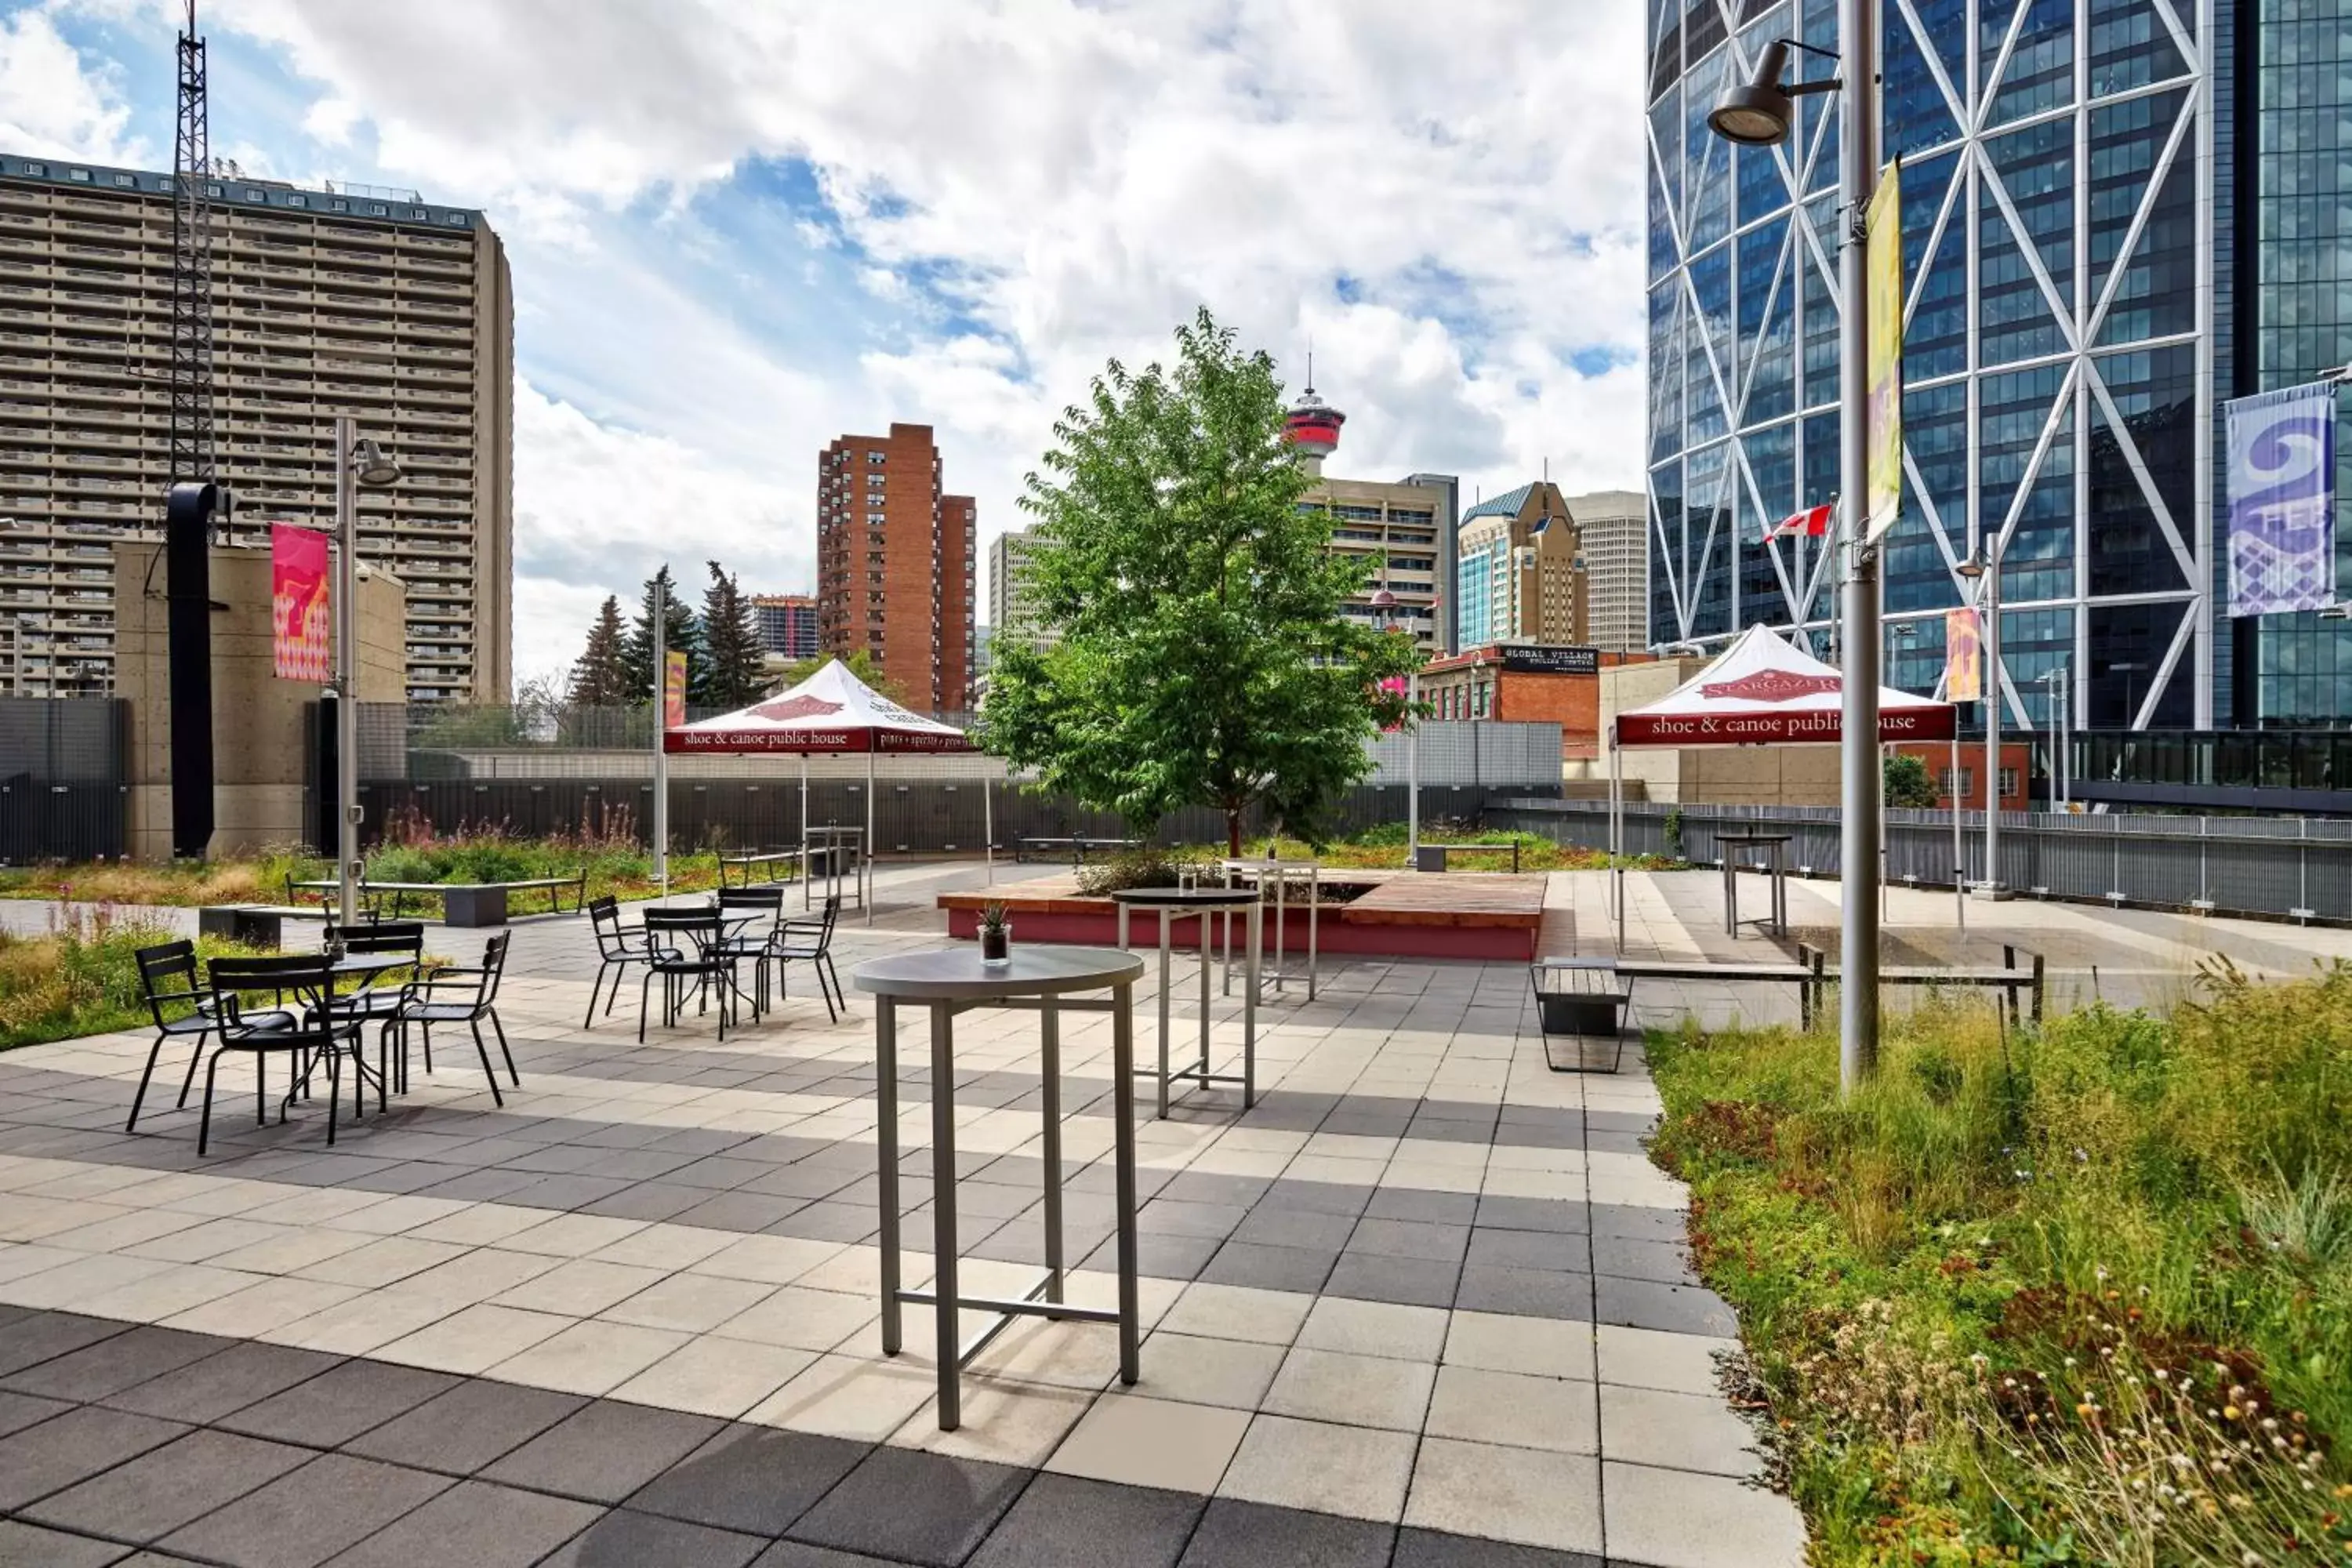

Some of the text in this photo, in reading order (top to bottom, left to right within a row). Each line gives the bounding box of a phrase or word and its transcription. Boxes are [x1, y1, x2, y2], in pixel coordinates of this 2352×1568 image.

[1551, 652, 1595, 660] VILLAGE
[1708, 679, 1838, 695] STARGAZER
[1652, 716, 1694, 733] shoe
[1700, 716, 1720, 733] &
[1726, 719, 1781, 732] canoe
[1877, 717, 1916, 729] use
[684, 731, 848, 748] shoe & canoe public house
